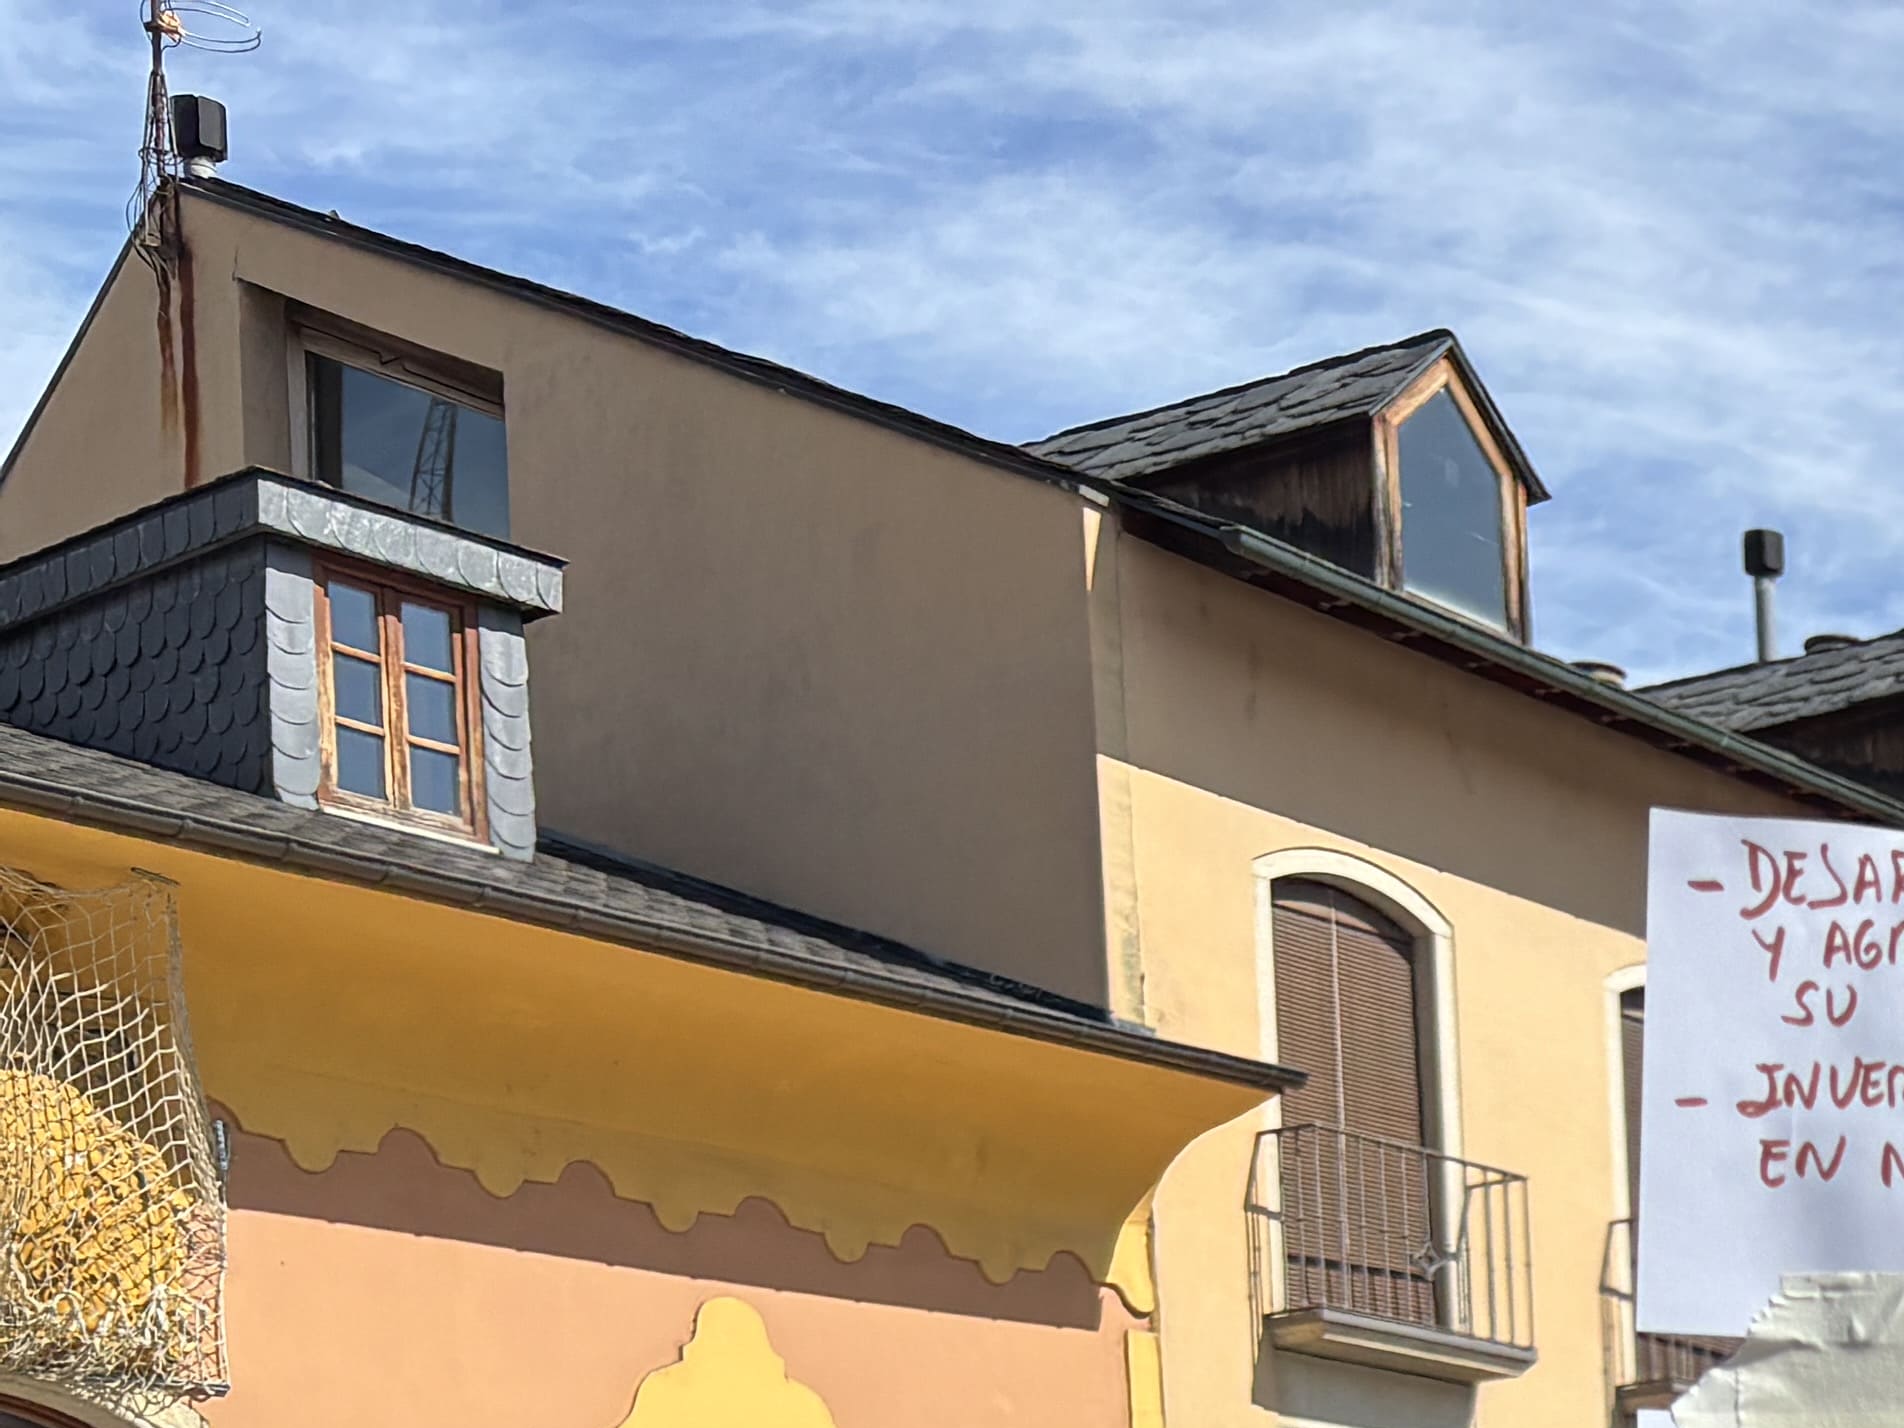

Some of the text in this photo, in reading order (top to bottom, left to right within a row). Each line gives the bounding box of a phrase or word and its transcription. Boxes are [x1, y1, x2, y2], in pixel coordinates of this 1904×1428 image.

[1752, 928, 1787, 982] Y
[1782, 981, 1859, 1028] SU
[1760, 1136, 1847, 1189] EN
